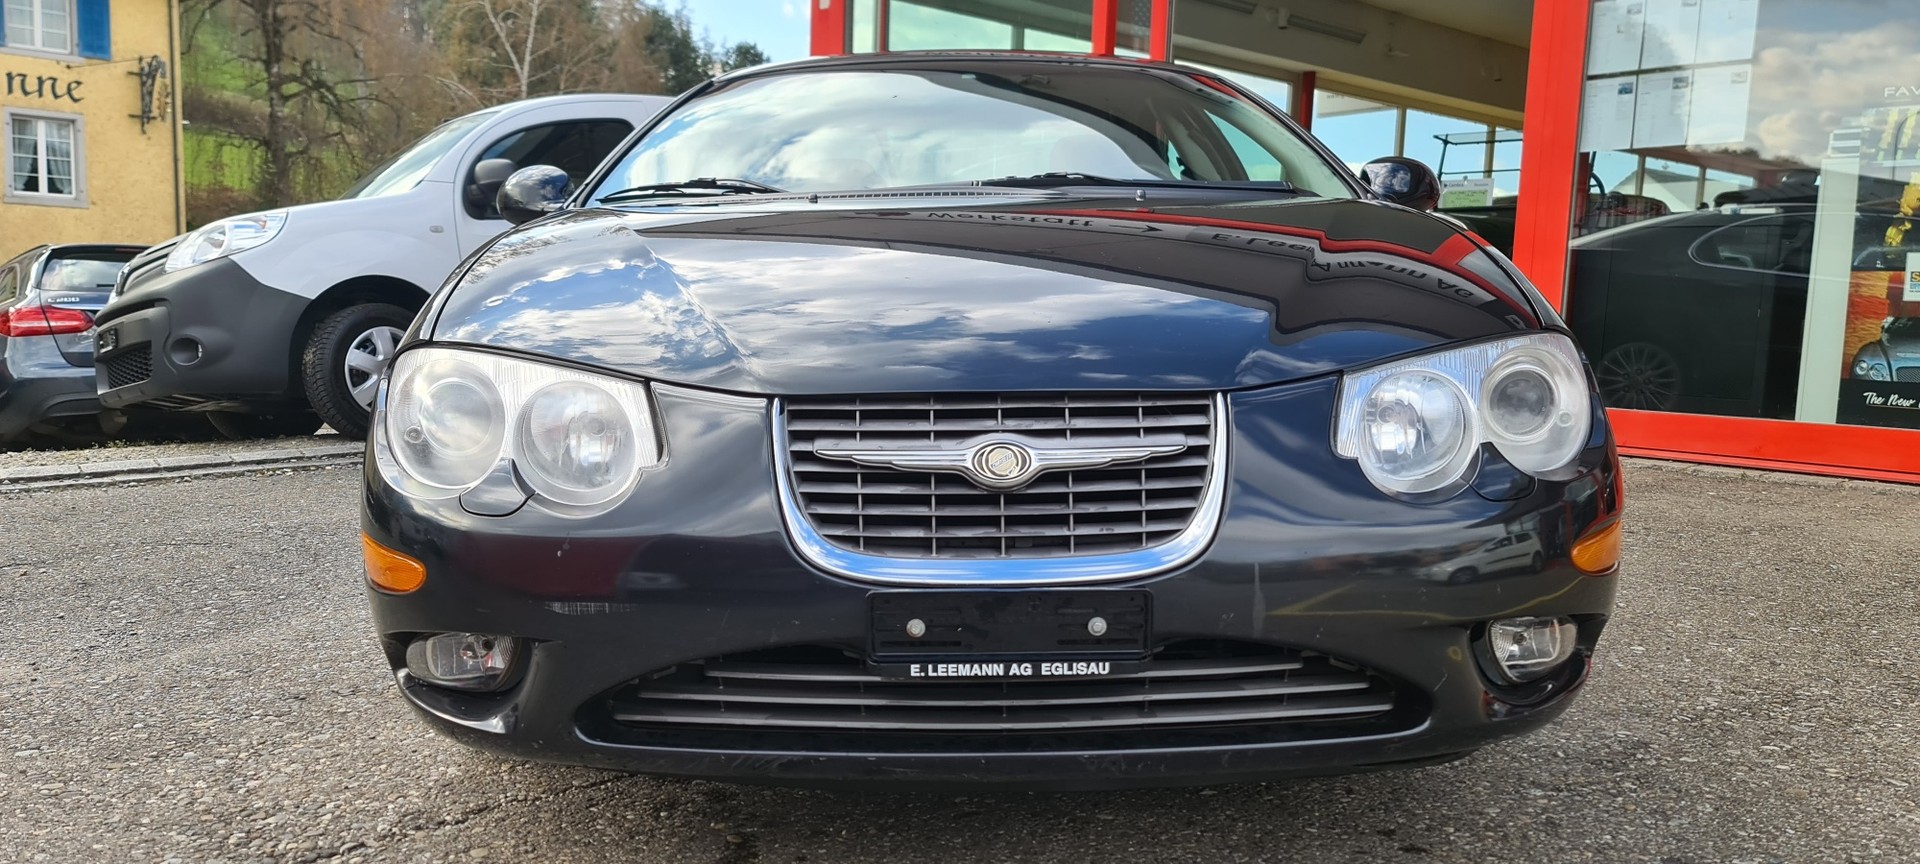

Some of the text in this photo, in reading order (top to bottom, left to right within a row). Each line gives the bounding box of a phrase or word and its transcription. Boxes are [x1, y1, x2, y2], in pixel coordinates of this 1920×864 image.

[1863, 392, 1885, 405] The
[1887, 394, 1916, 407] New
[910, 662, 1110, 677] E. LEEMANN AG EGLISAU
